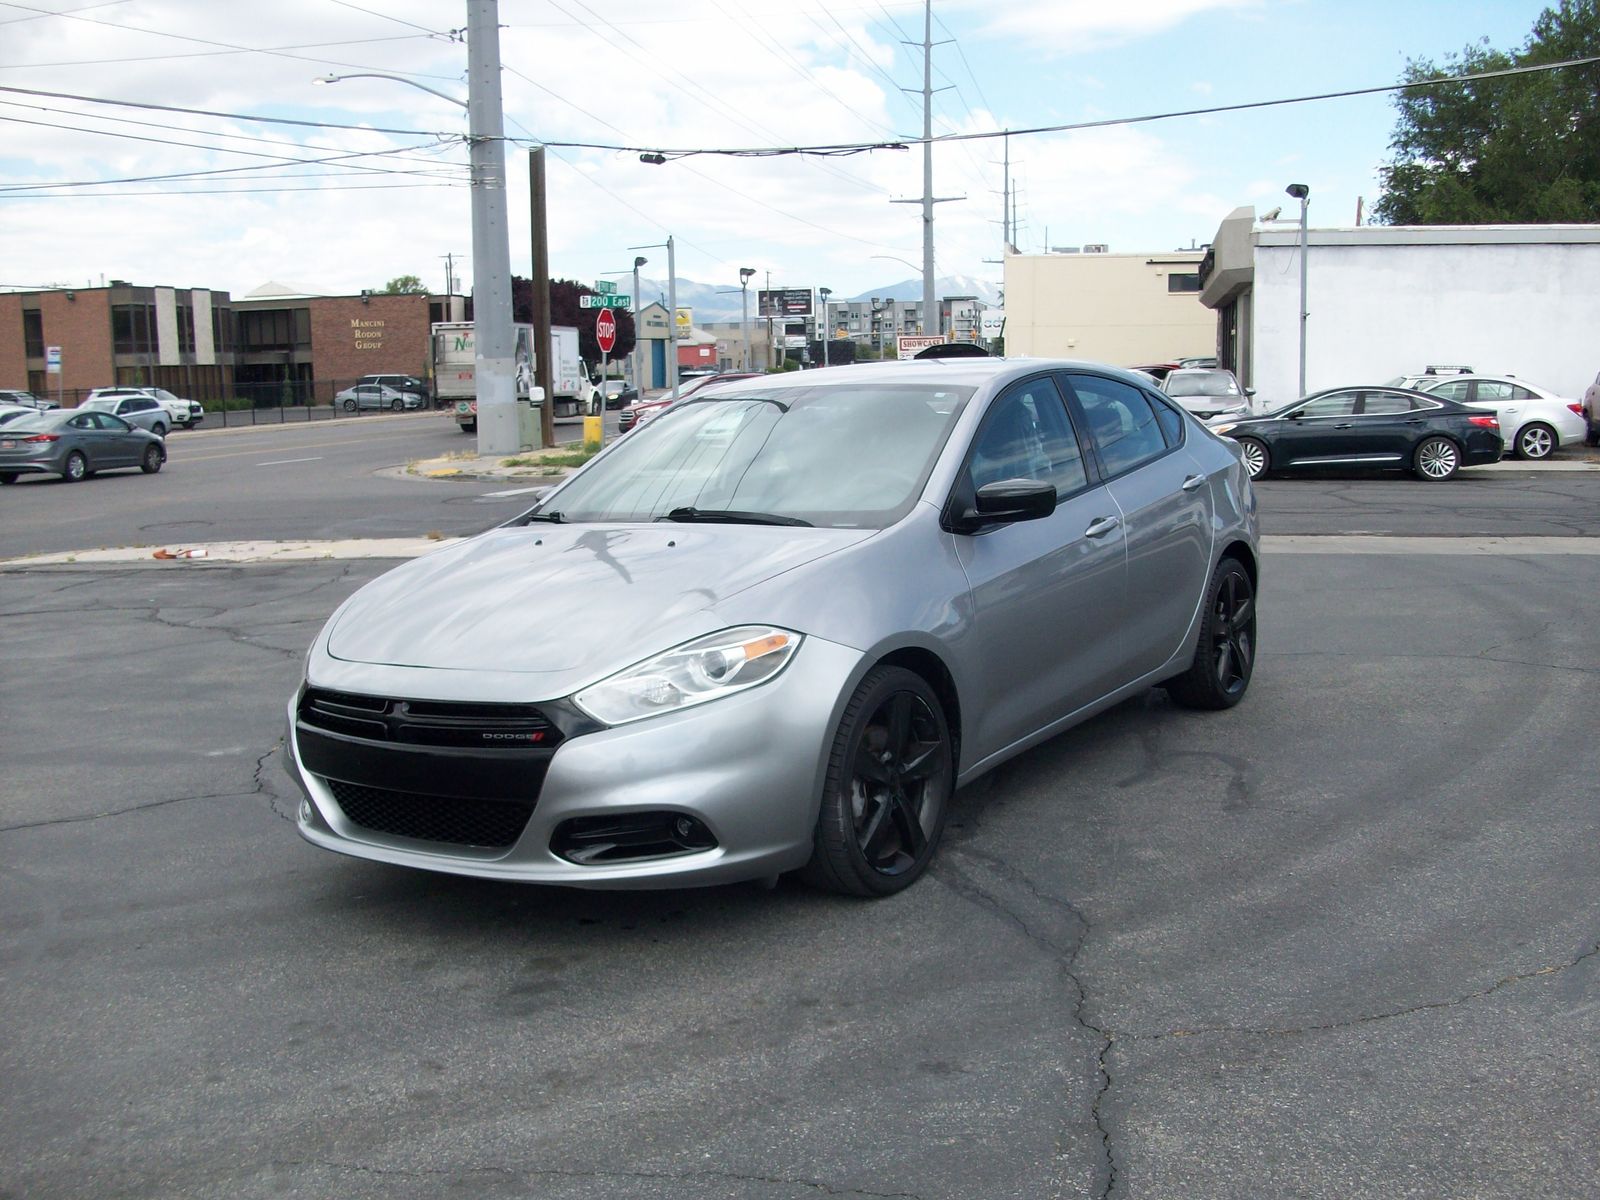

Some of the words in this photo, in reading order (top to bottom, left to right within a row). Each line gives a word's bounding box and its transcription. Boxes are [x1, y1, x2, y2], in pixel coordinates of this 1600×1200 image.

[592, 297, 608, 306] 200
[612, 297, 630, 306] East
[351, 319, 385, 327] MANCINI
[599, 322, 615, 338] STOP
[355, 341, 382, 349] GROUP
[903, 339, 941, 348] SHOWCASE
